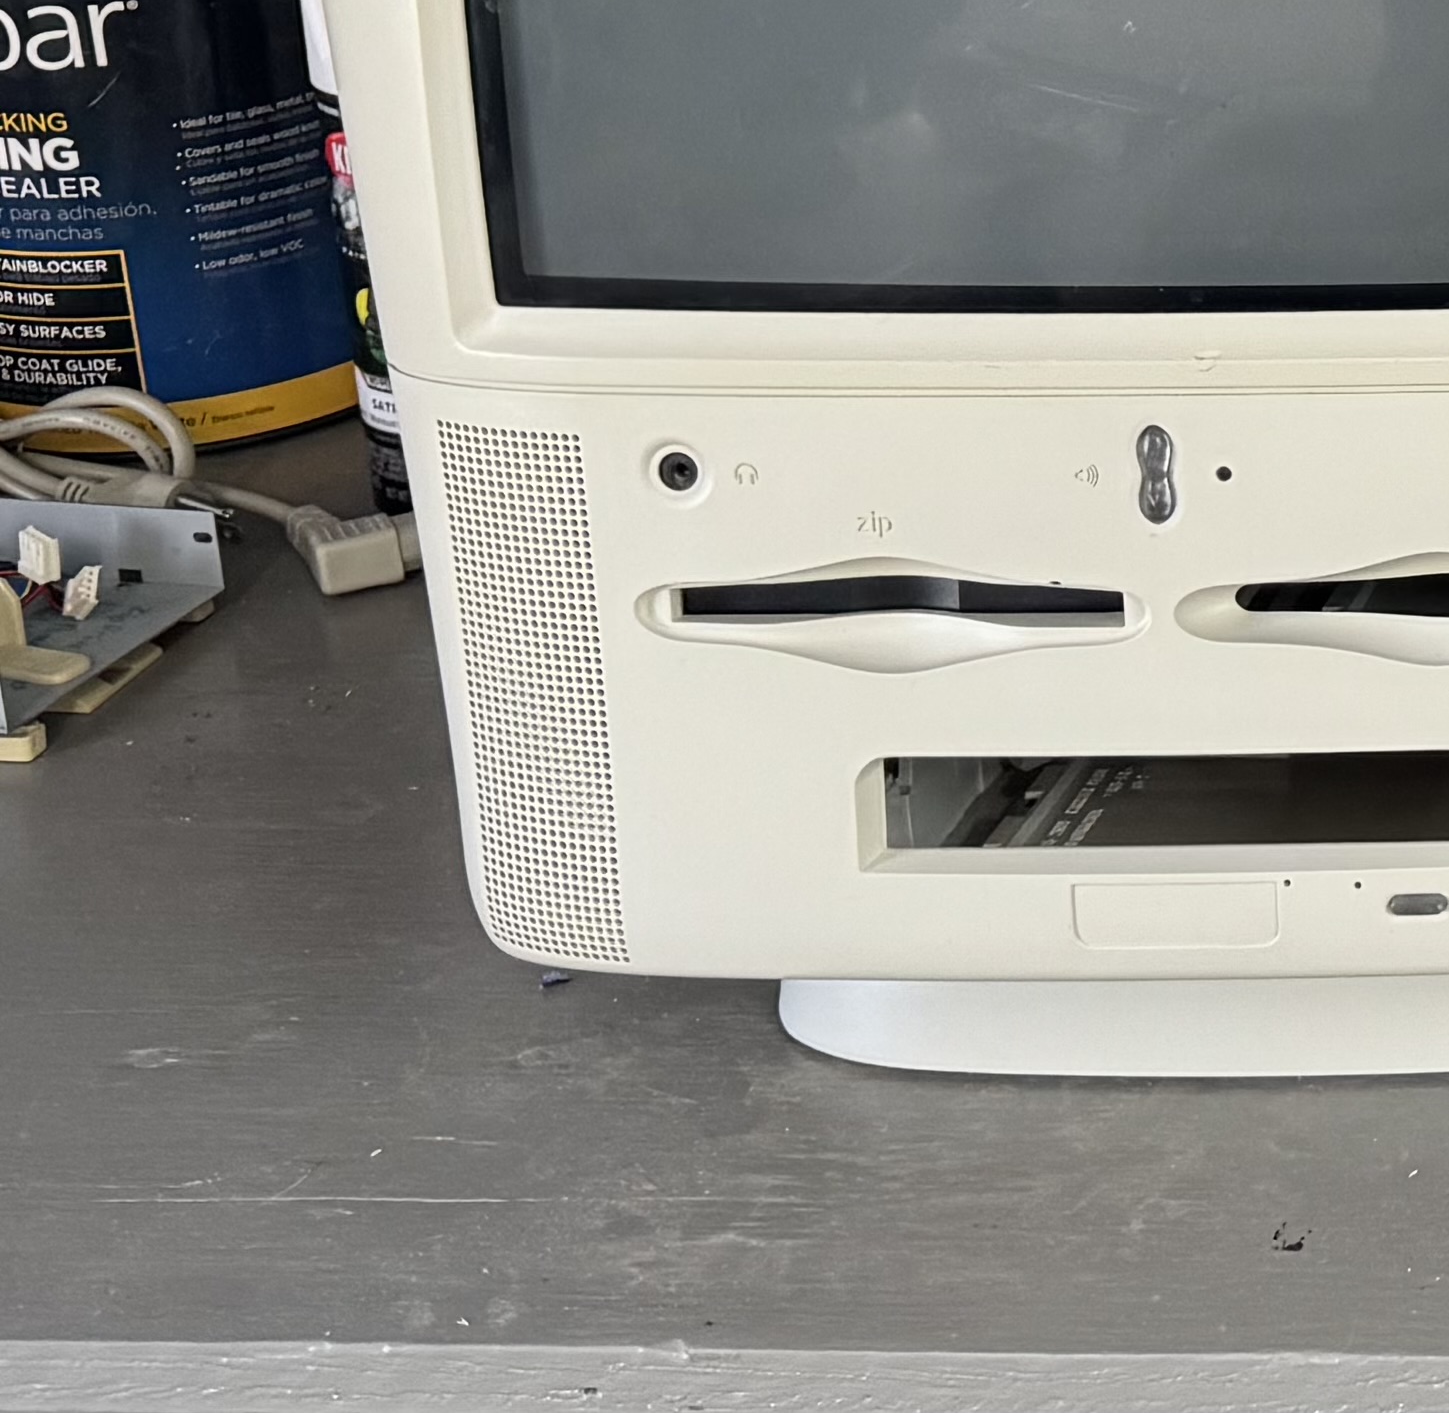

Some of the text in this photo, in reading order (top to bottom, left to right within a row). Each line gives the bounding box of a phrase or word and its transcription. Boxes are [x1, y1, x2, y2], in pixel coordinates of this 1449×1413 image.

[0, 112, 69, 133] KING
[10, 207, 51, 223] para
[16, 225, 104, 241] manchas
[0, 258, 108, 274] AINBLOCKER
[17, 291, 56, 307] HIDE
[20, 324, 107, 339] SURFACES
[18, 357, 60, 372] COAT
[65, 357, 122, 373] GLIDE,
[14, 369, 108, 386] DURABILITY
[857, 510, 893, 538] zip
